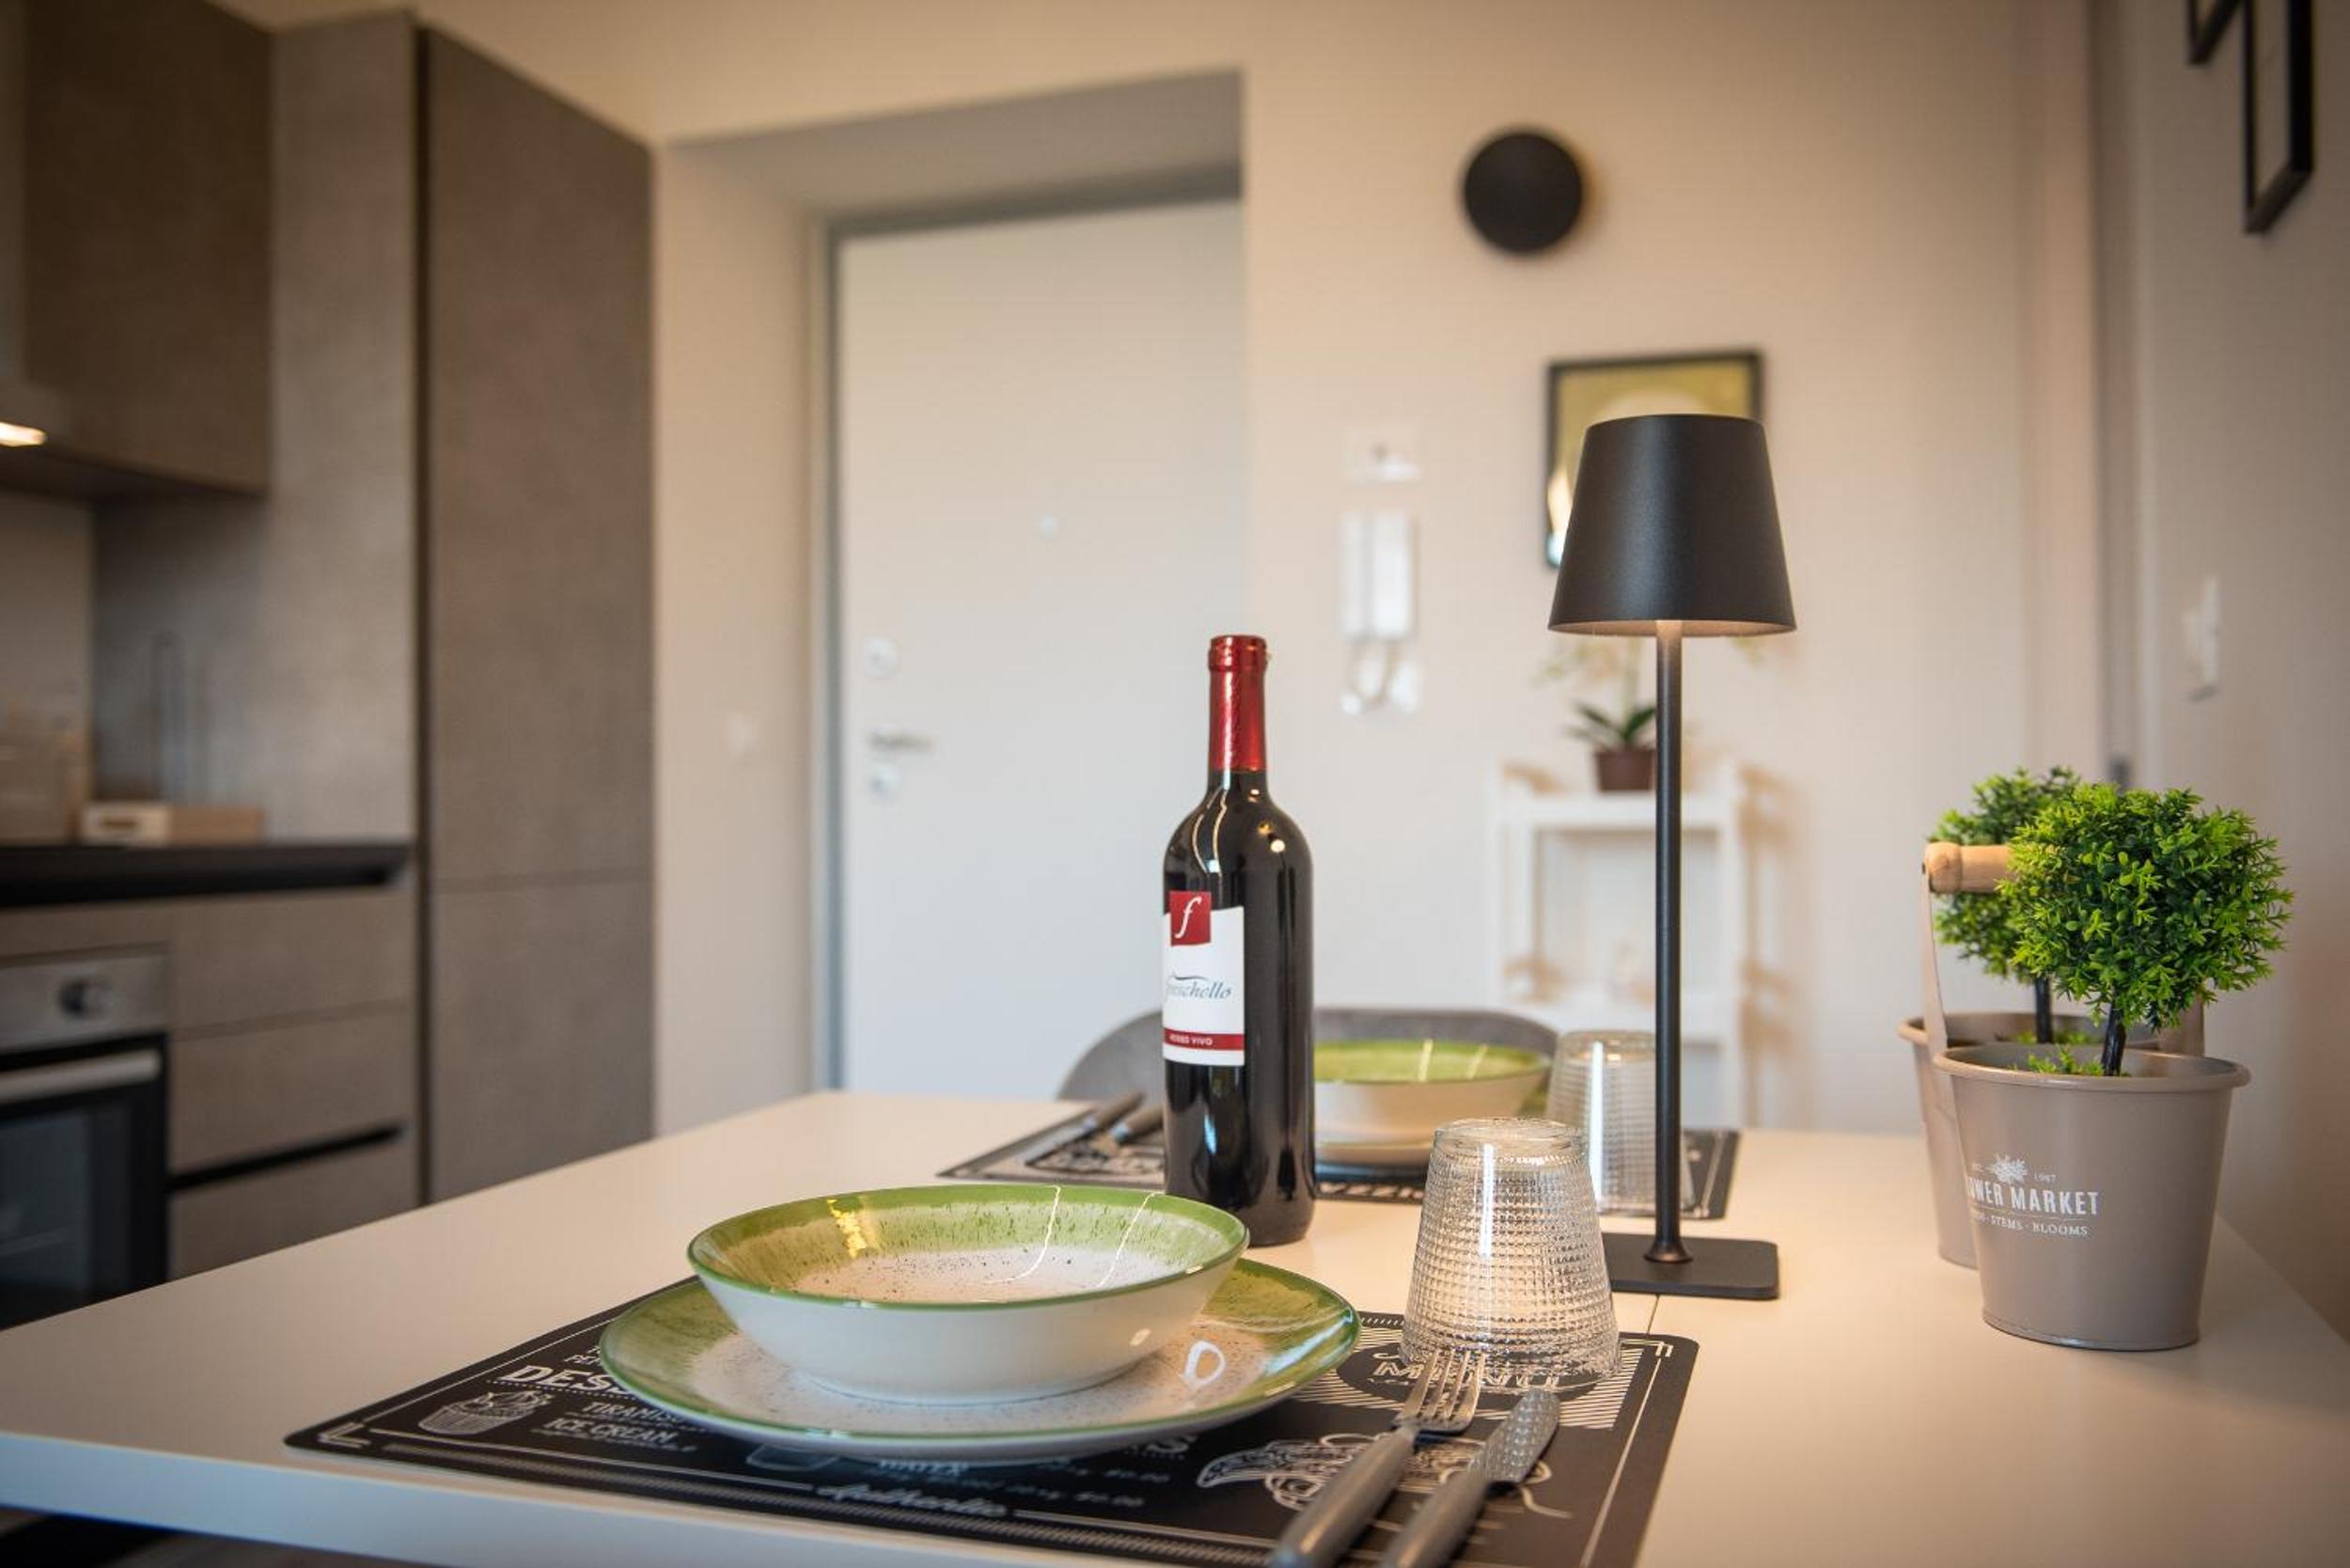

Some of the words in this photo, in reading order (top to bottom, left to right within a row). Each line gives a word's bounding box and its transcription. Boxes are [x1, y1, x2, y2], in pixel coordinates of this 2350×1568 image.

[1175, 896, 1202, 938] f
[2010, 1186, 2099, 1215] MARKET
[1991, 1215, 2023, 1230] STEMS
[2032, 1222, 2088, 1236] BLOOMS
[542, 1418, 592, 1435] ICE
[590, 1423, 679, 1444] CREAM
